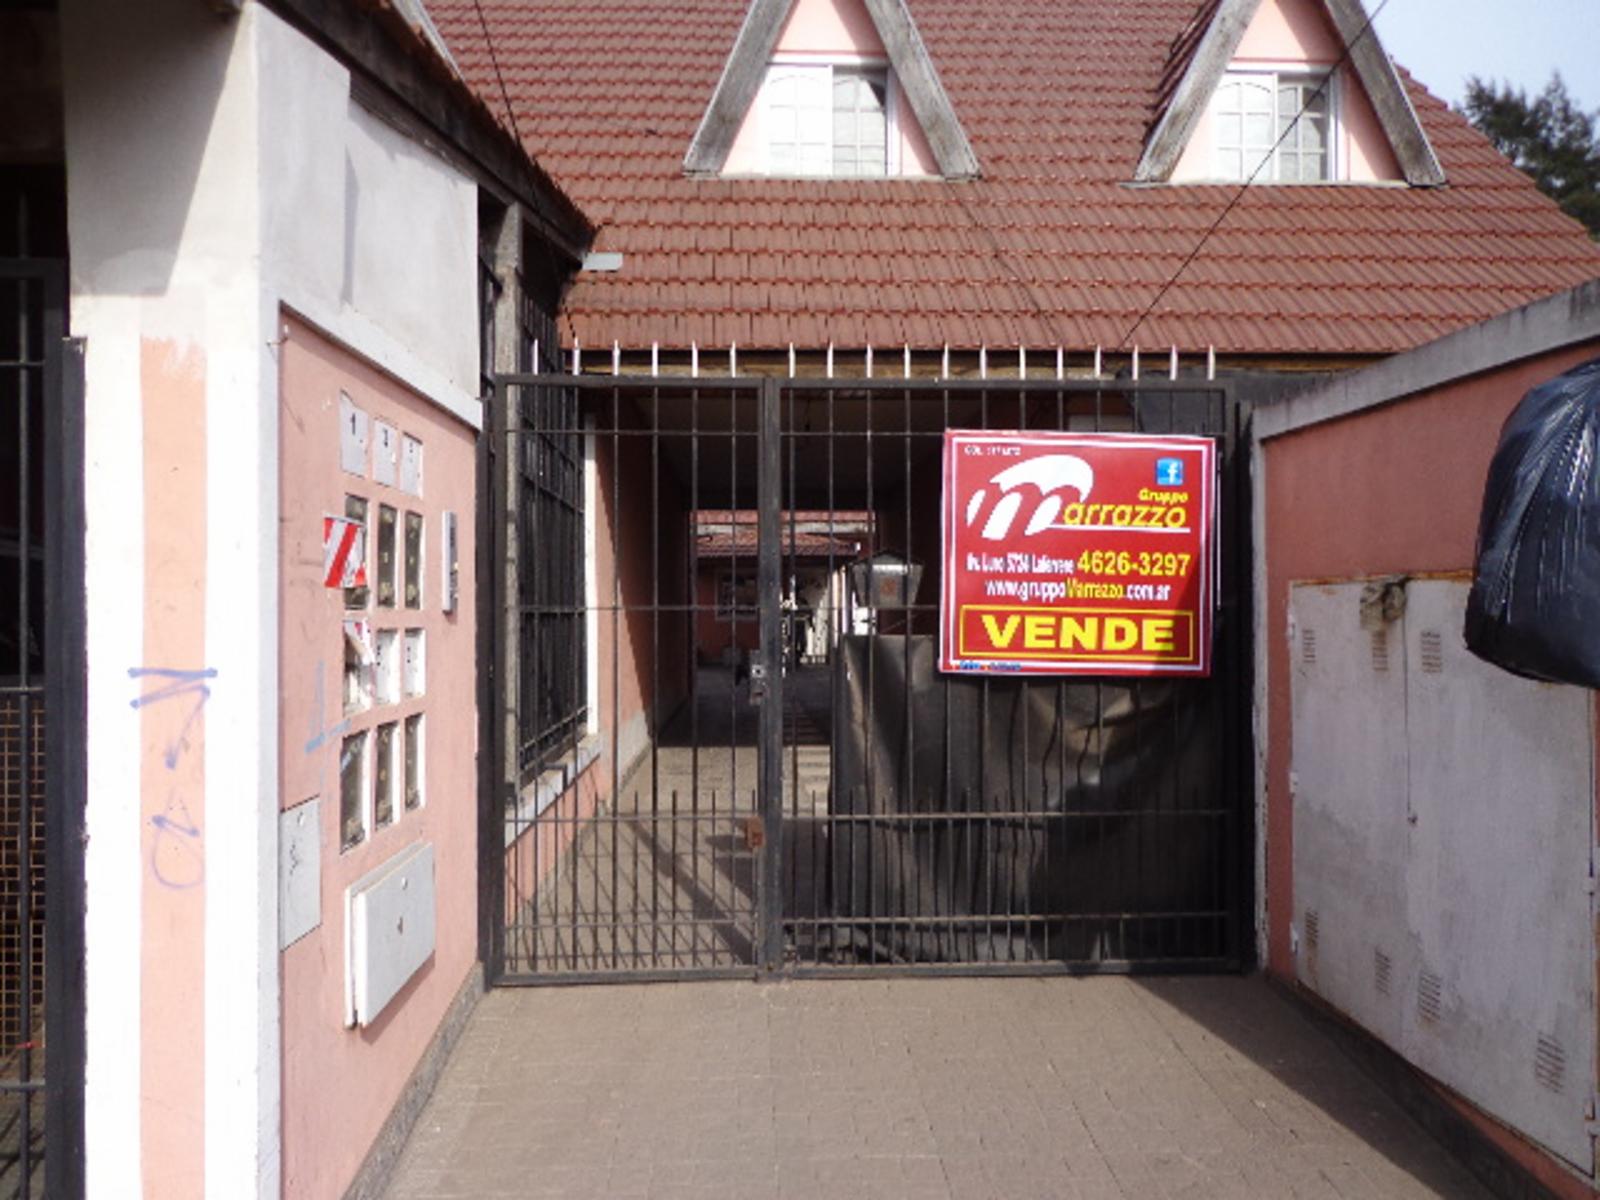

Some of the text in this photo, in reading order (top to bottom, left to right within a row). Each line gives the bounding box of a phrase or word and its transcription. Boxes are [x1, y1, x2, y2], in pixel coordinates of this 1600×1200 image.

[1138, 487, 1189, 506] Gruppo
[1077, 550, 1191, 576] 4626-3297
[981, 614, 1175, 651] VENDE
